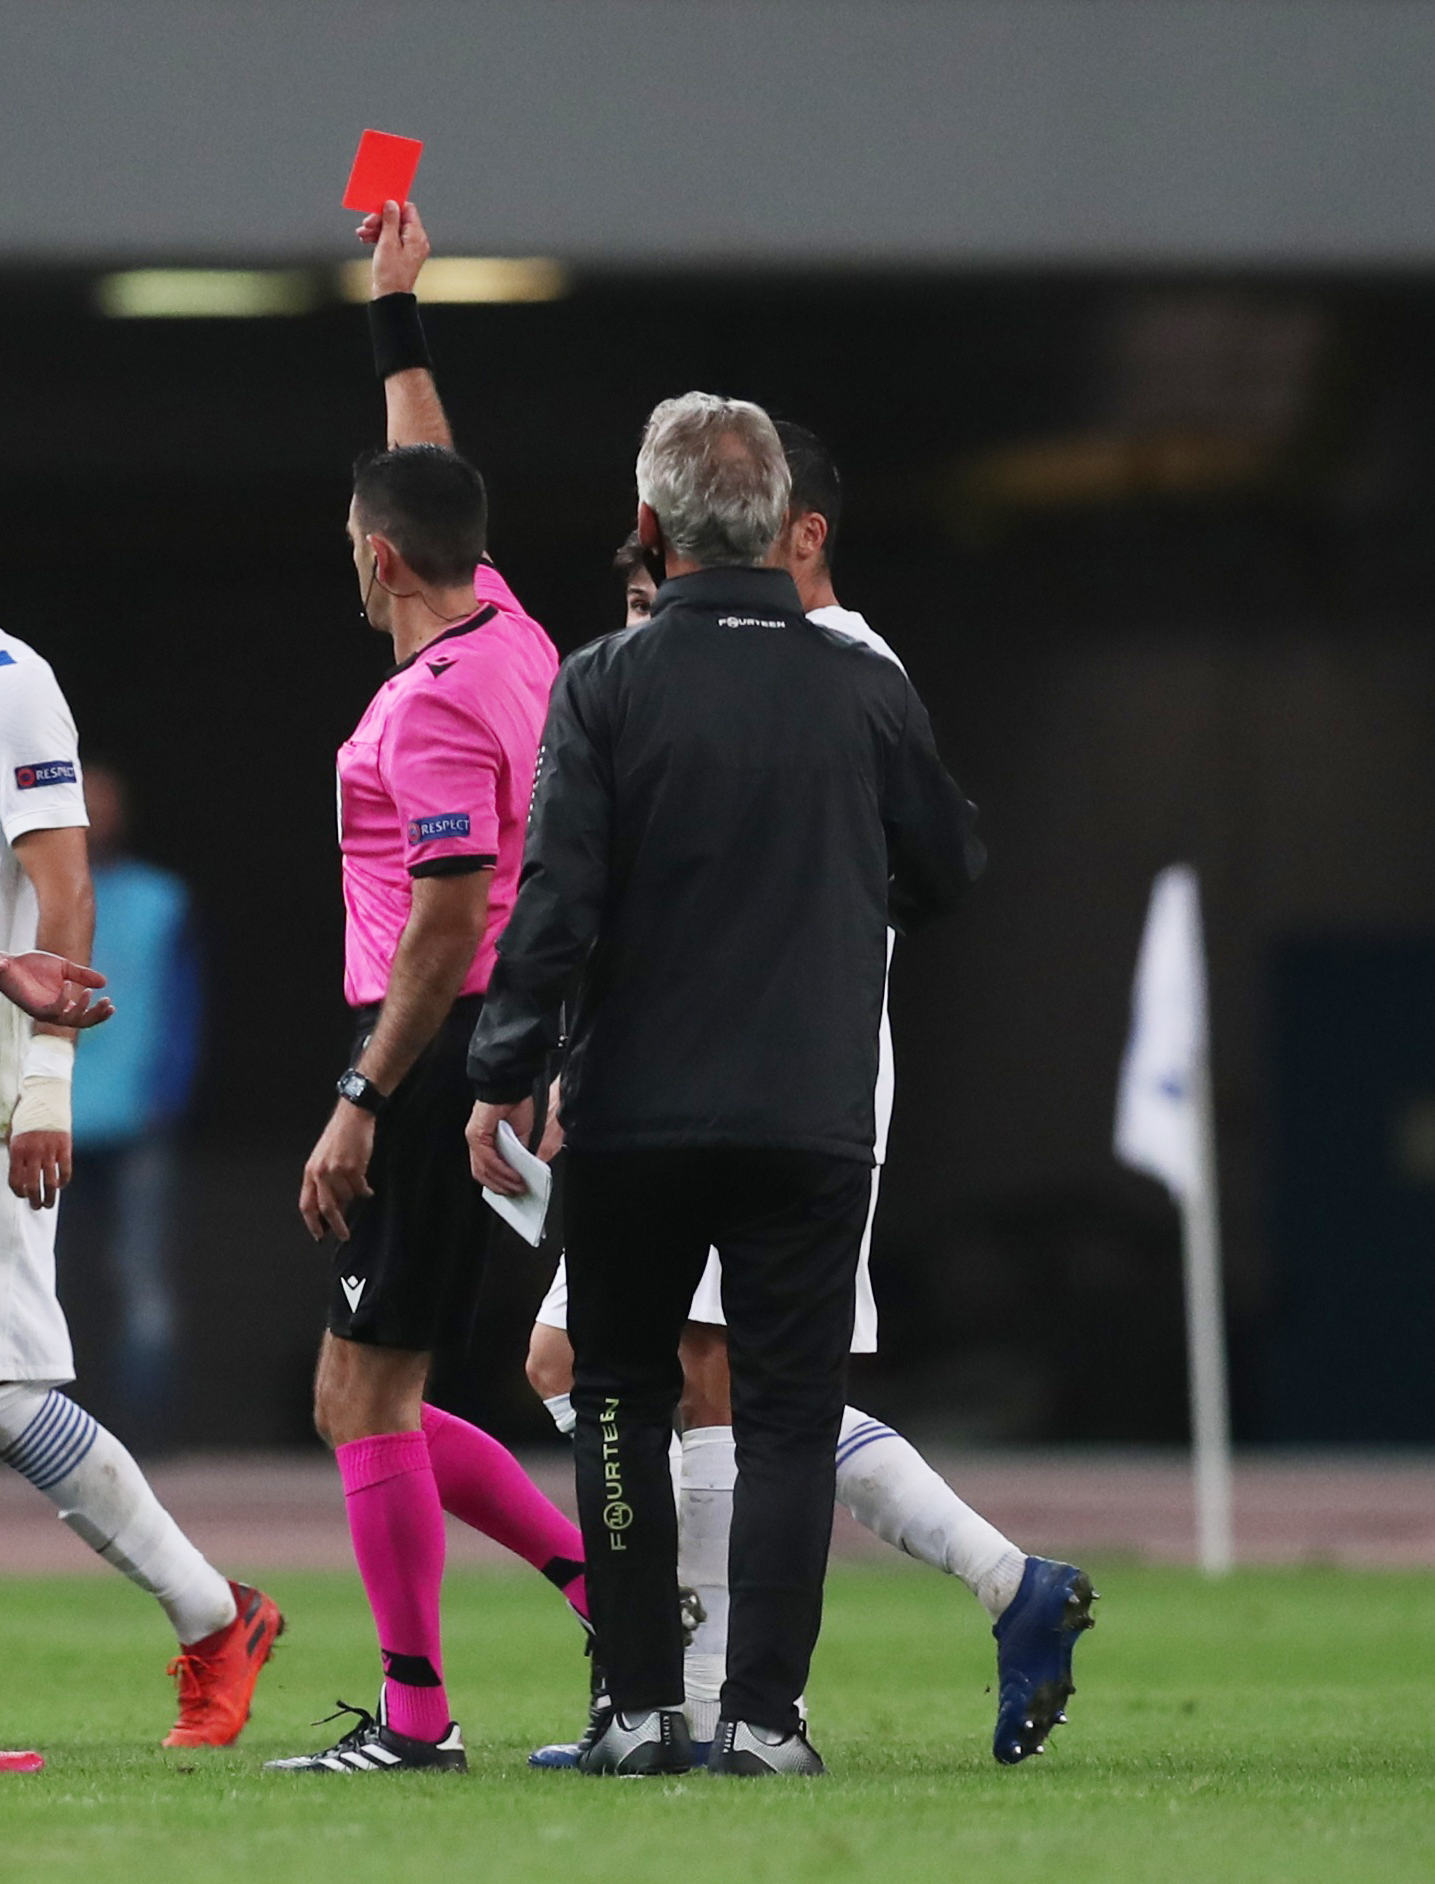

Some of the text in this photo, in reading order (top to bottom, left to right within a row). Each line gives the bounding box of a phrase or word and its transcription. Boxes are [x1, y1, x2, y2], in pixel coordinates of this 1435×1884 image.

[421, 819, 470, 835] RESPECT
[599, 1398, 633, 1550] FOURTEEN
[723, 1722, 734, 1753] KIPSTA
